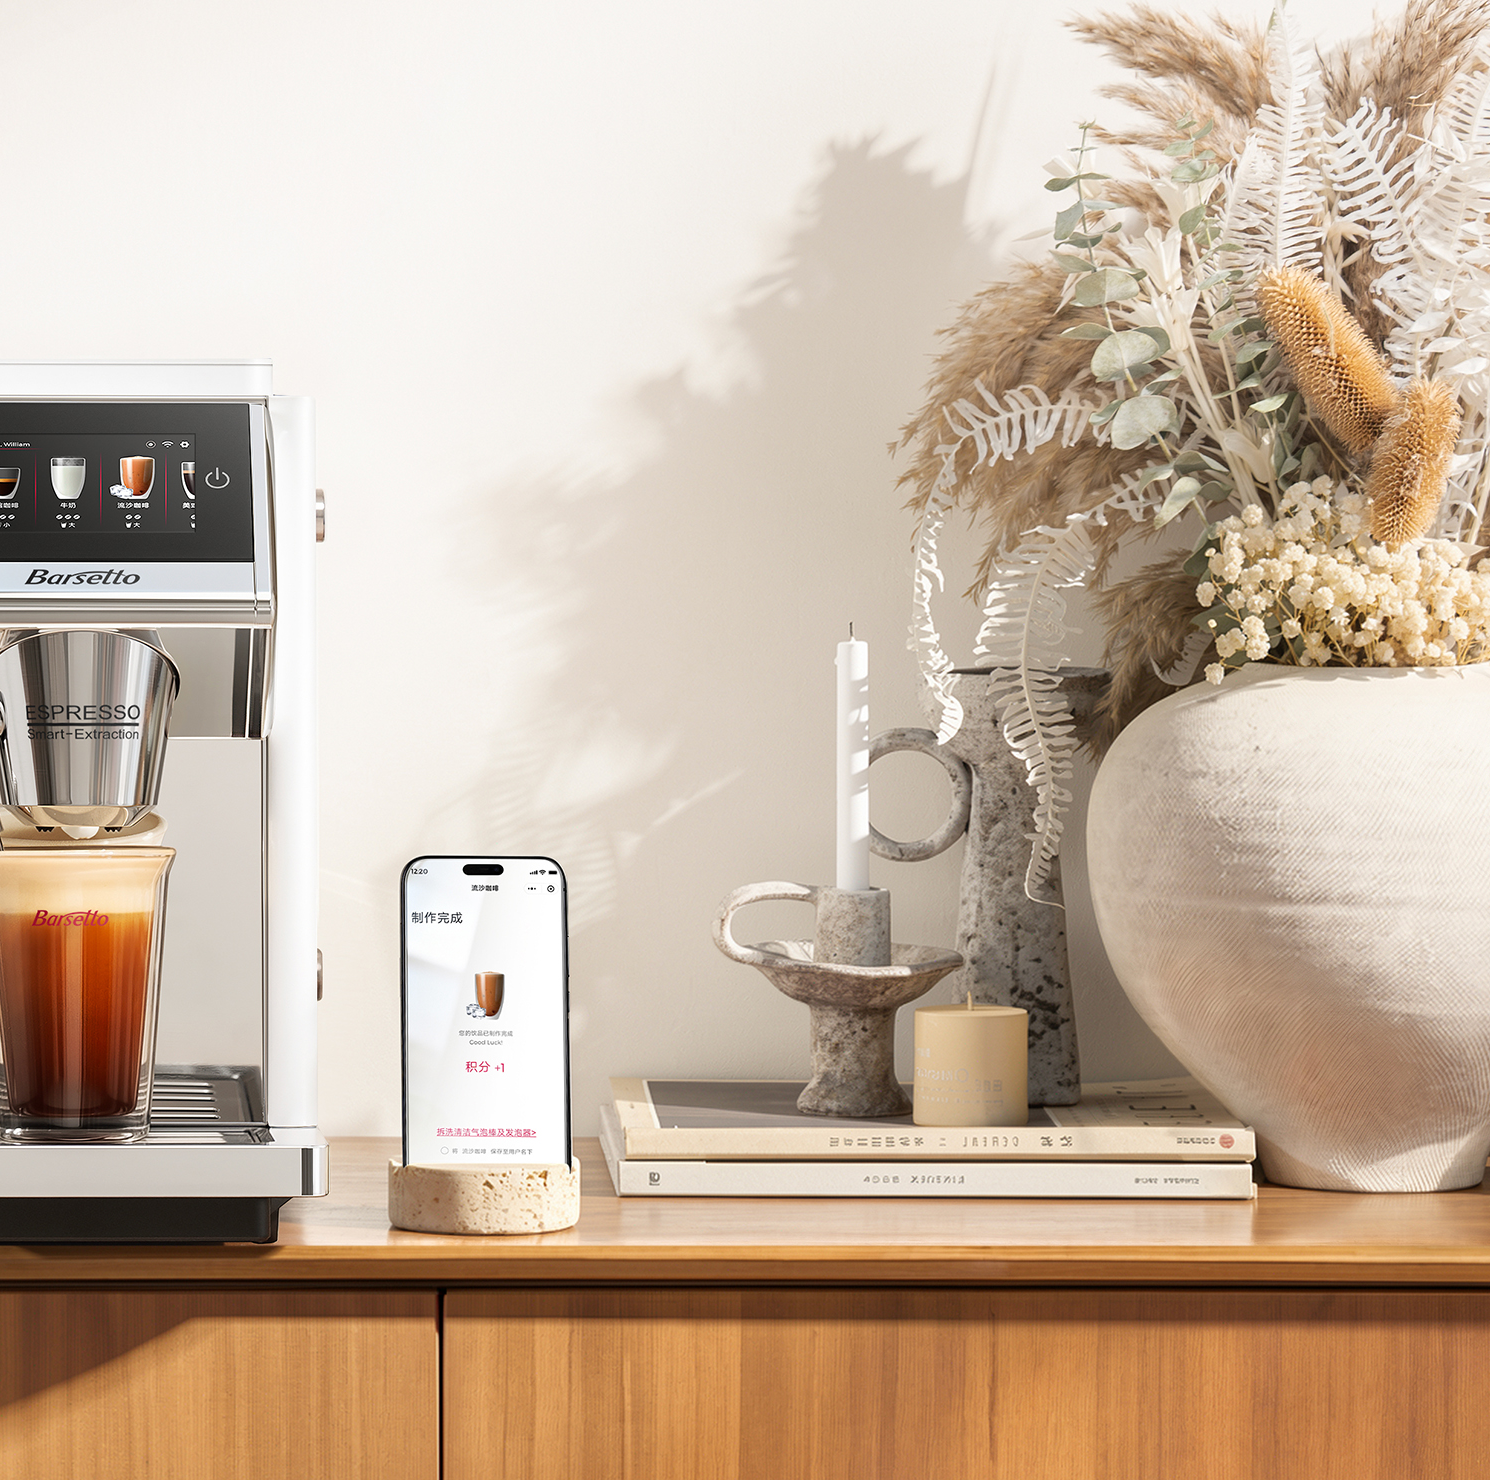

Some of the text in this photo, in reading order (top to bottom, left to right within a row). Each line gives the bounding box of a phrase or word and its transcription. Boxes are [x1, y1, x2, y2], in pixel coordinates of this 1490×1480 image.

[24, 568, 141, 586] Barsetto
[25, 704, 141, 721] ESPRESSO
[27, 728, 140, 740] Smart-Extraction
[471, 884, 500, 892] 流沙咖啡
[32, 909, 109, 927] Barsetto
[411, 911, 463, 924] 制作完成
[458, 1029, 514, 1037] 您的饮品已制作完成
[465, 1060, 505, 1073] 积分 +1
